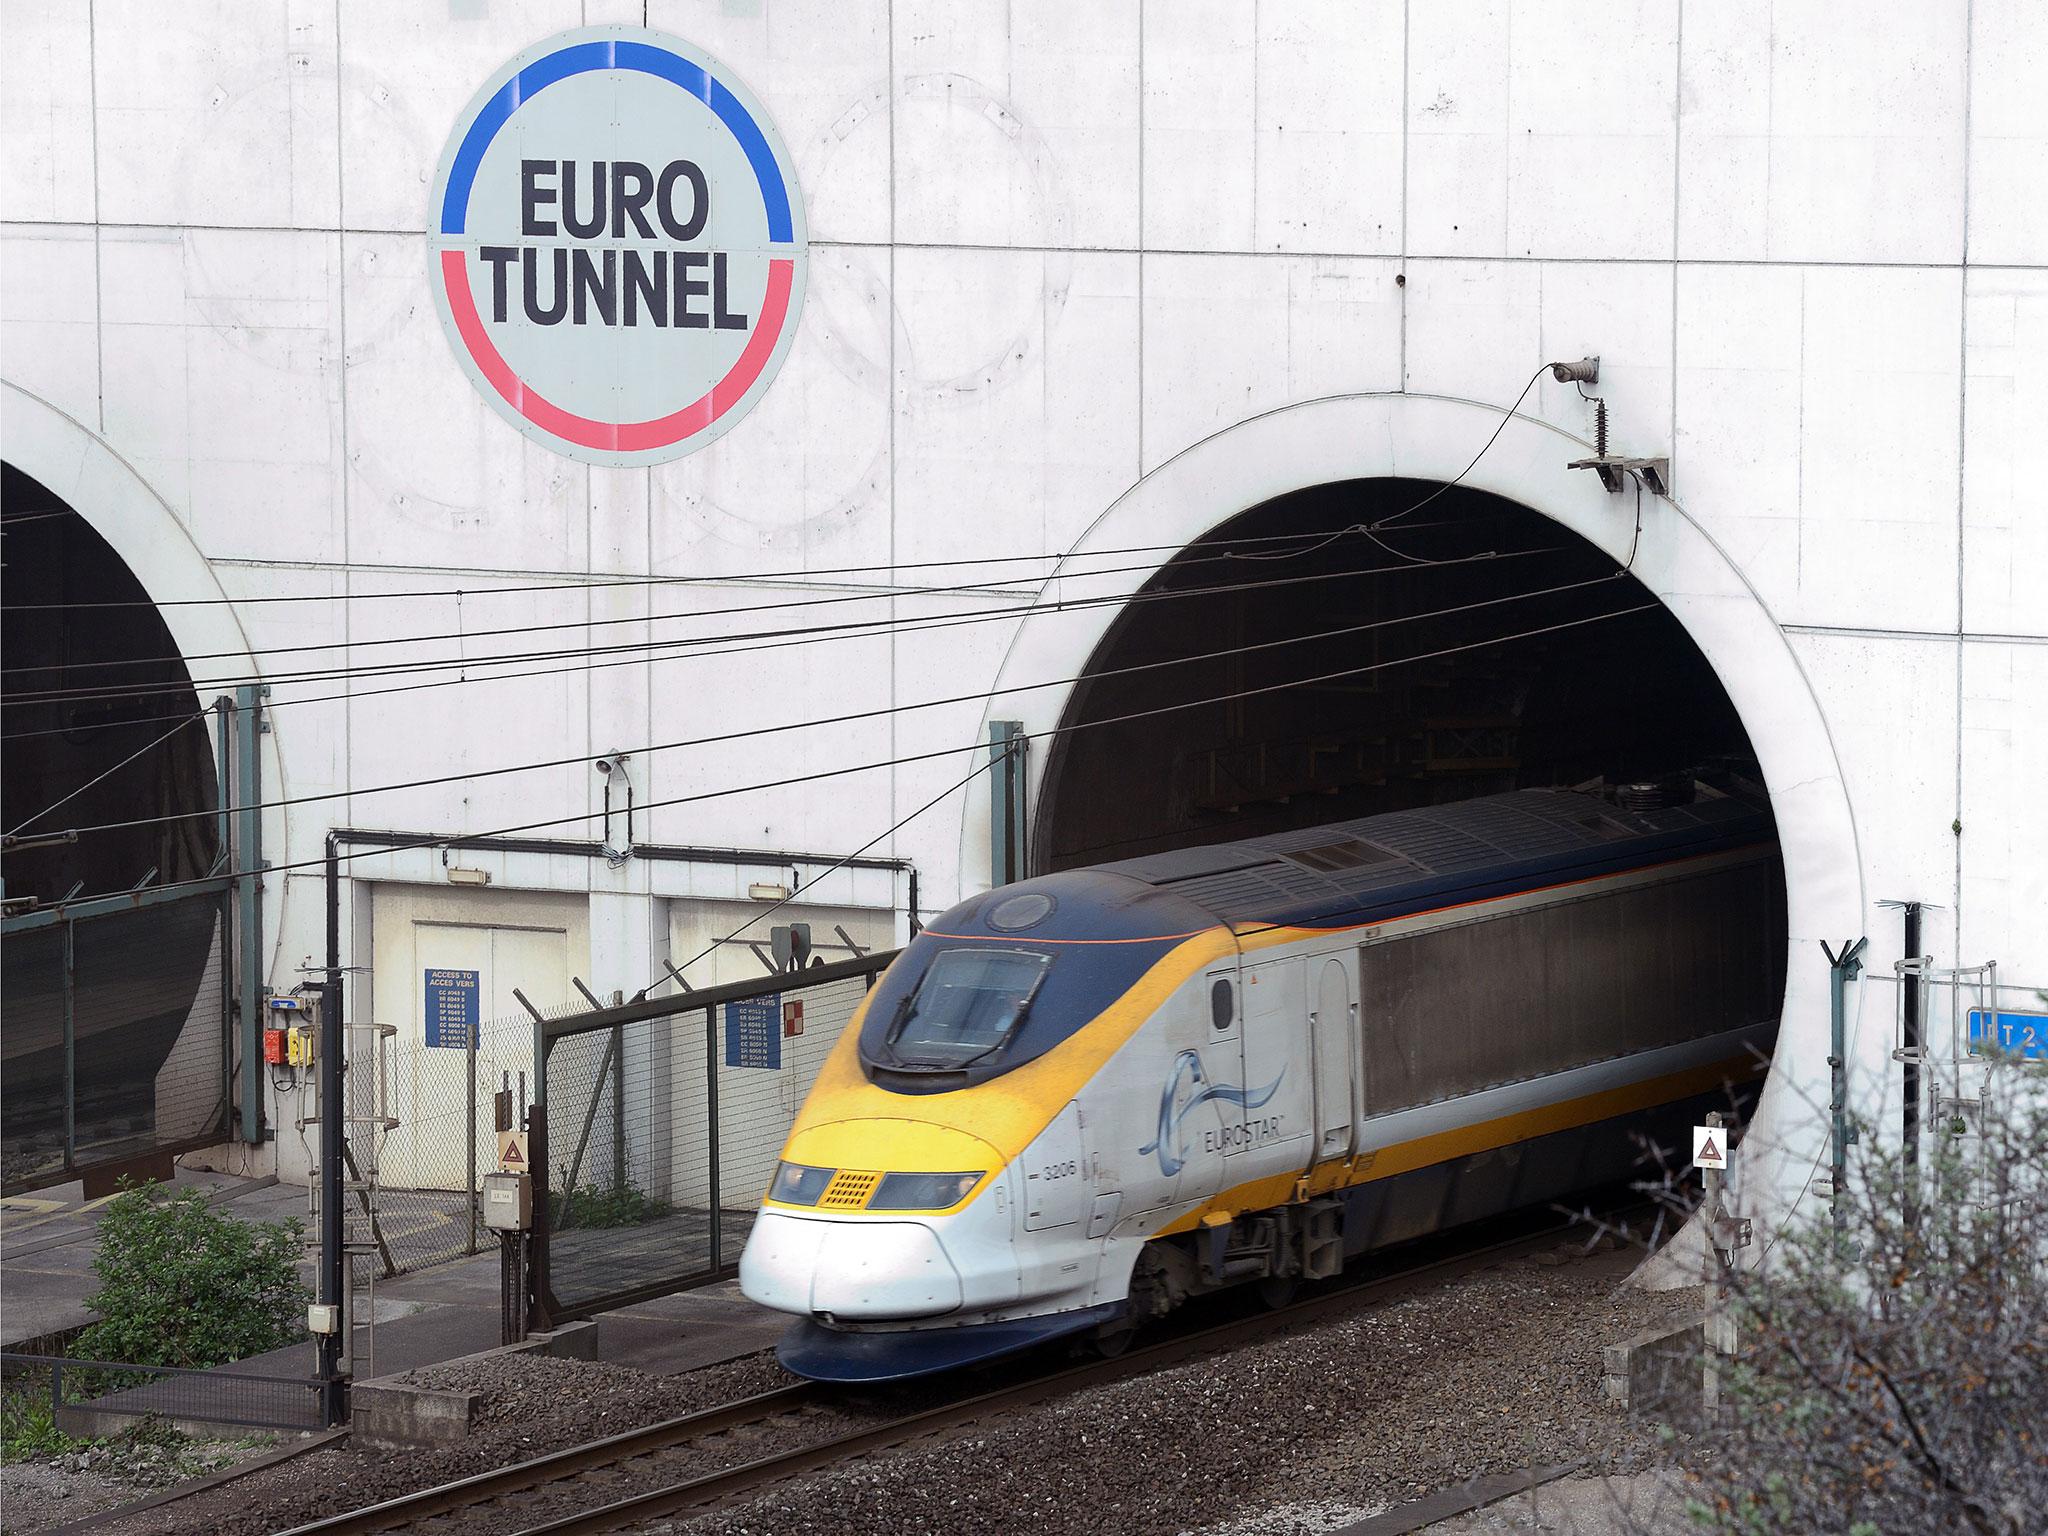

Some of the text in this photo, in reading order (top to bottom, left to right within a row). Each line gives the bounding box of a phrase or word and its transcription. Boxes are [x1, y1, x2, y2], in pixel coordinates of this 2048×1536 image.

[521, 160, 709, 241] EURO
[480, 246, 747, 330] TUNNEL
[429, 979, 453, 987] ACCES
[431, 971, 460, 979] ACCESS
[1204, 1115, 1280, 1153] EUROSTAR
[1043, 1160, 1077, 1181] 3206
